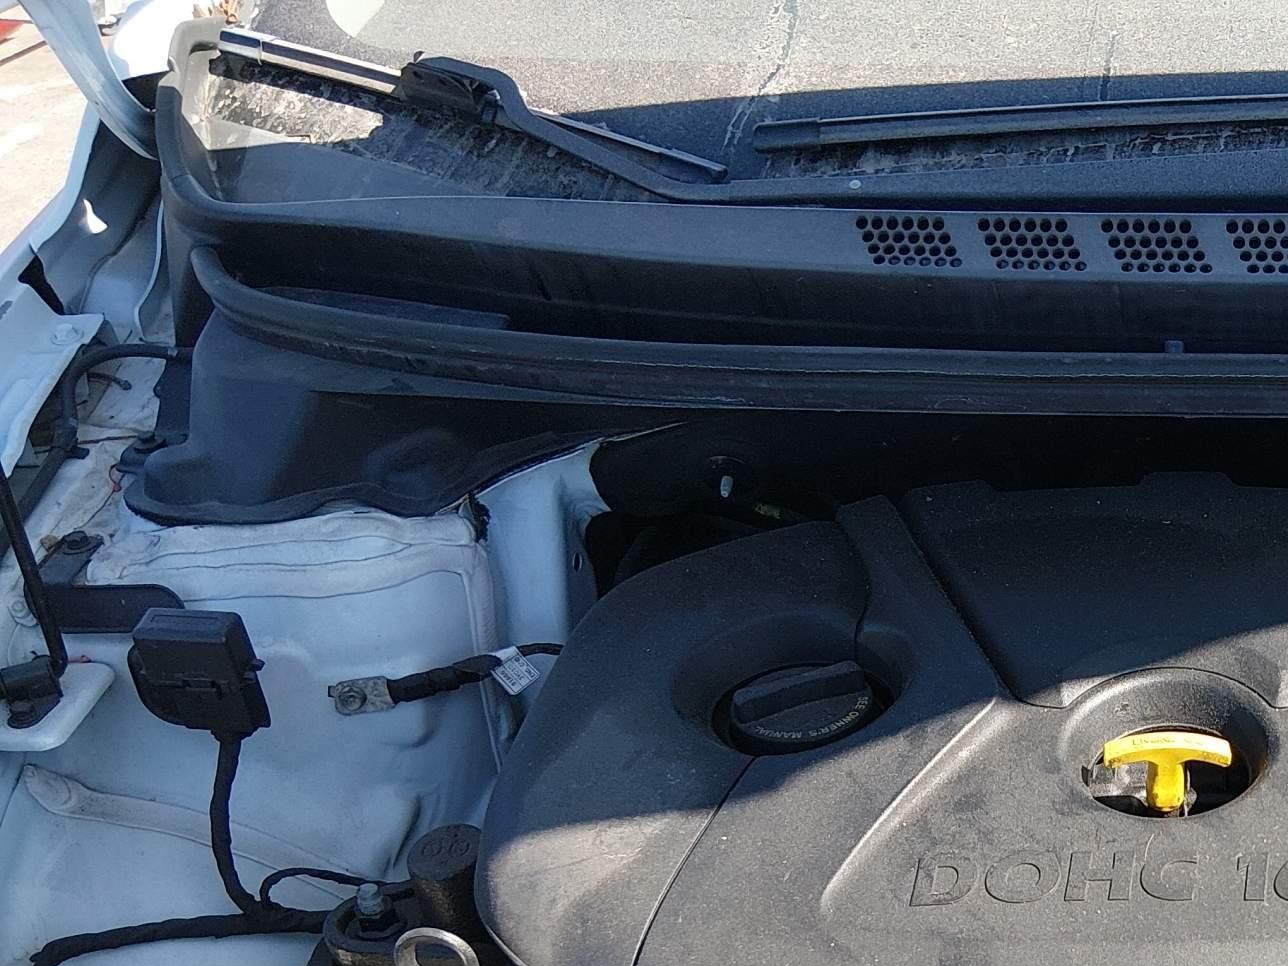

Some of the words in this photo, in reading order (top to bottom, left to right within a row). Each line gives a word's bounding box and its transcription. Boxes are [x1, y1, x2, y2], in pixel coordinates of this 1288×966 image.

[755, 726, 803, 739] MANUAL
[808, 711, 860, 737] OWNER'S
[908, 849, 1199, 907] DOHC
